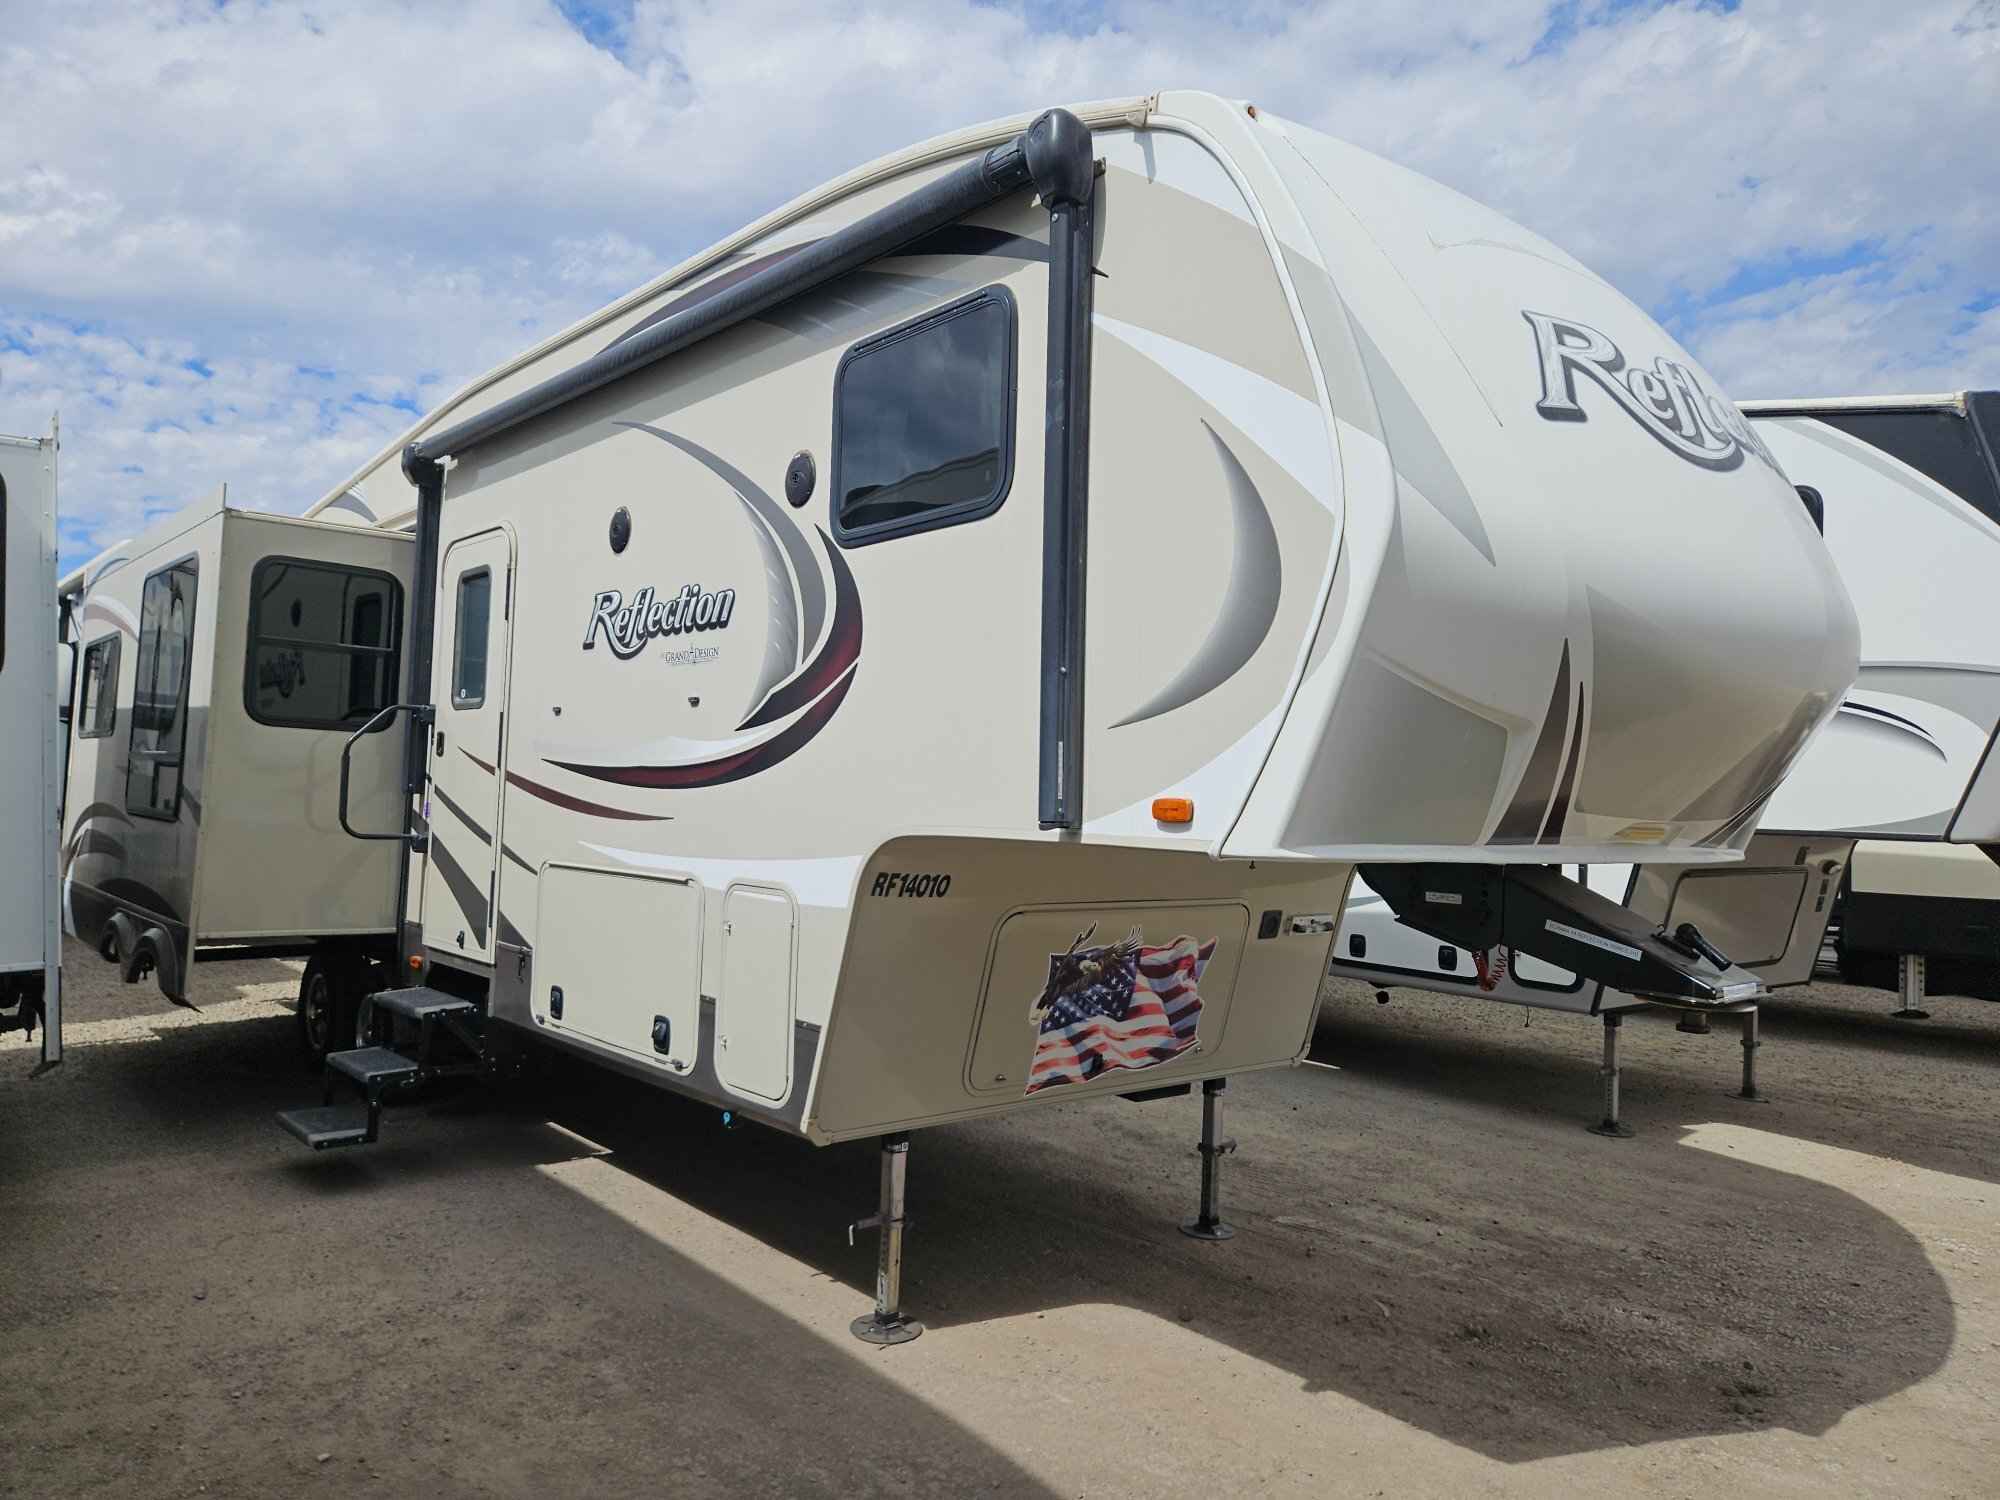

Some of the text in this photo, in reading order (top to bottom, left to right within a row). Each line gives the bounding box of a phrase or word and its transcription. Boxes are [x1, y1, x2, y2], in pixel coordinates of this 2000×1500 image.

[583, 584, 736, 661] Reflection
[665, 651, 689, 663] GRAND
[694, 646, 719, 659] DESIGN
[870, 871, 952, 898] RF14010
